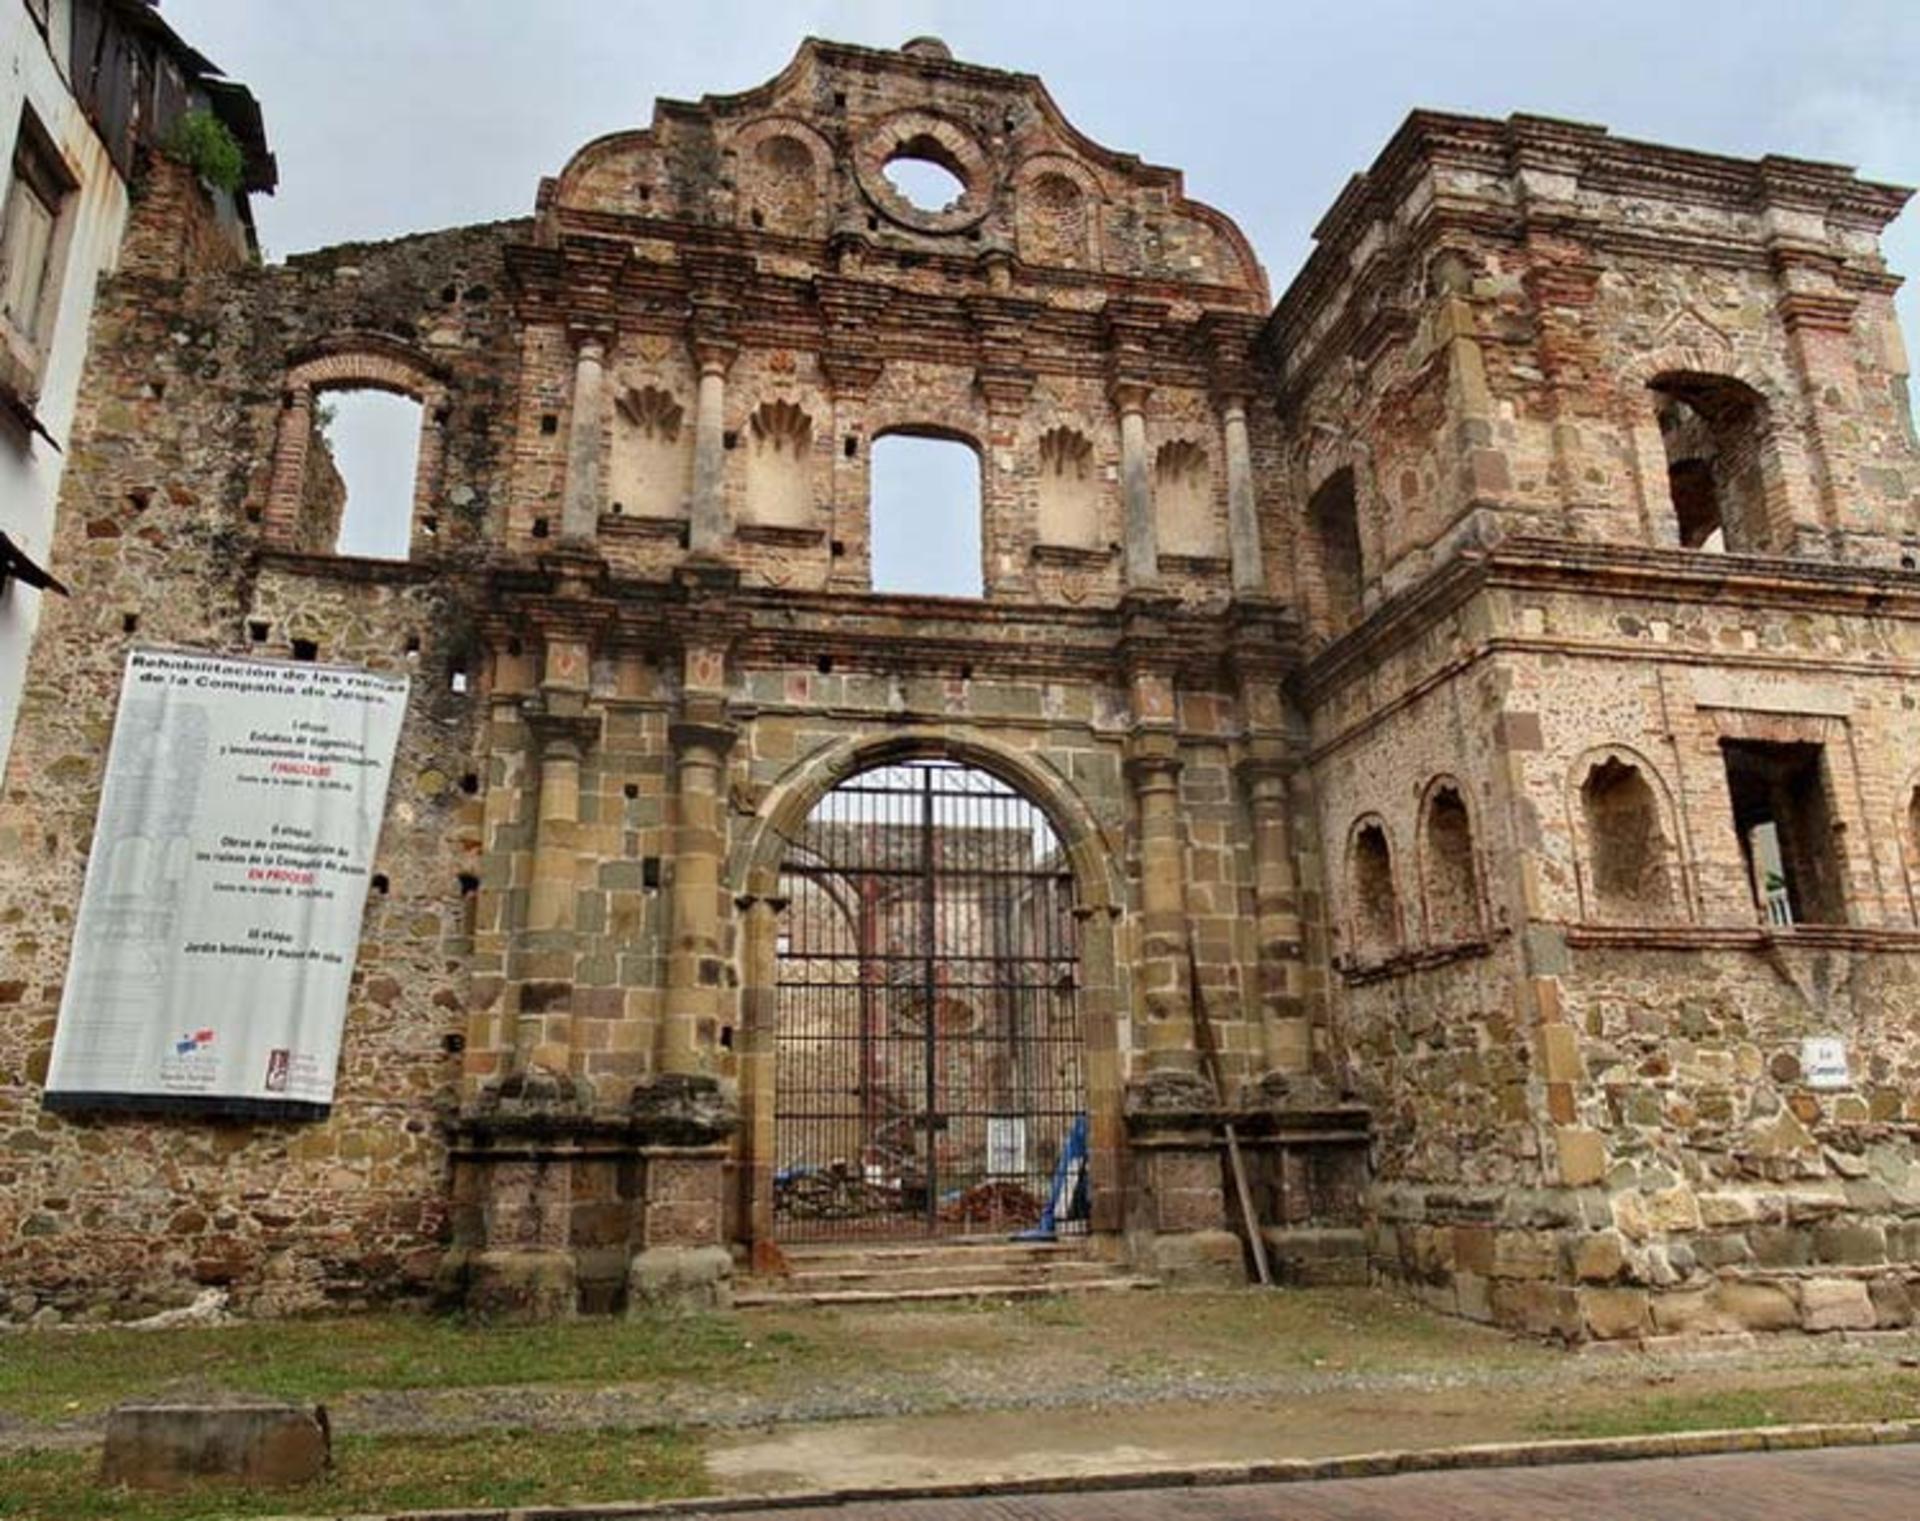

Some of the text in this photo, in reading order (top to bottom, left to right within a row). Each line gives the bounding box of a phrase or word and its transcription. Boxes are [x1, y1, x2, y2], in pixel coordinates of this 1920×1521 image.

[282, 669, 306, 681] de
[313, 671, 342, 684] las
[139, 672, 164, 683] de
[169, 674, 188, 686] la
[301, 685, 326, 697] de
[247, 866, 264, 881] EN
